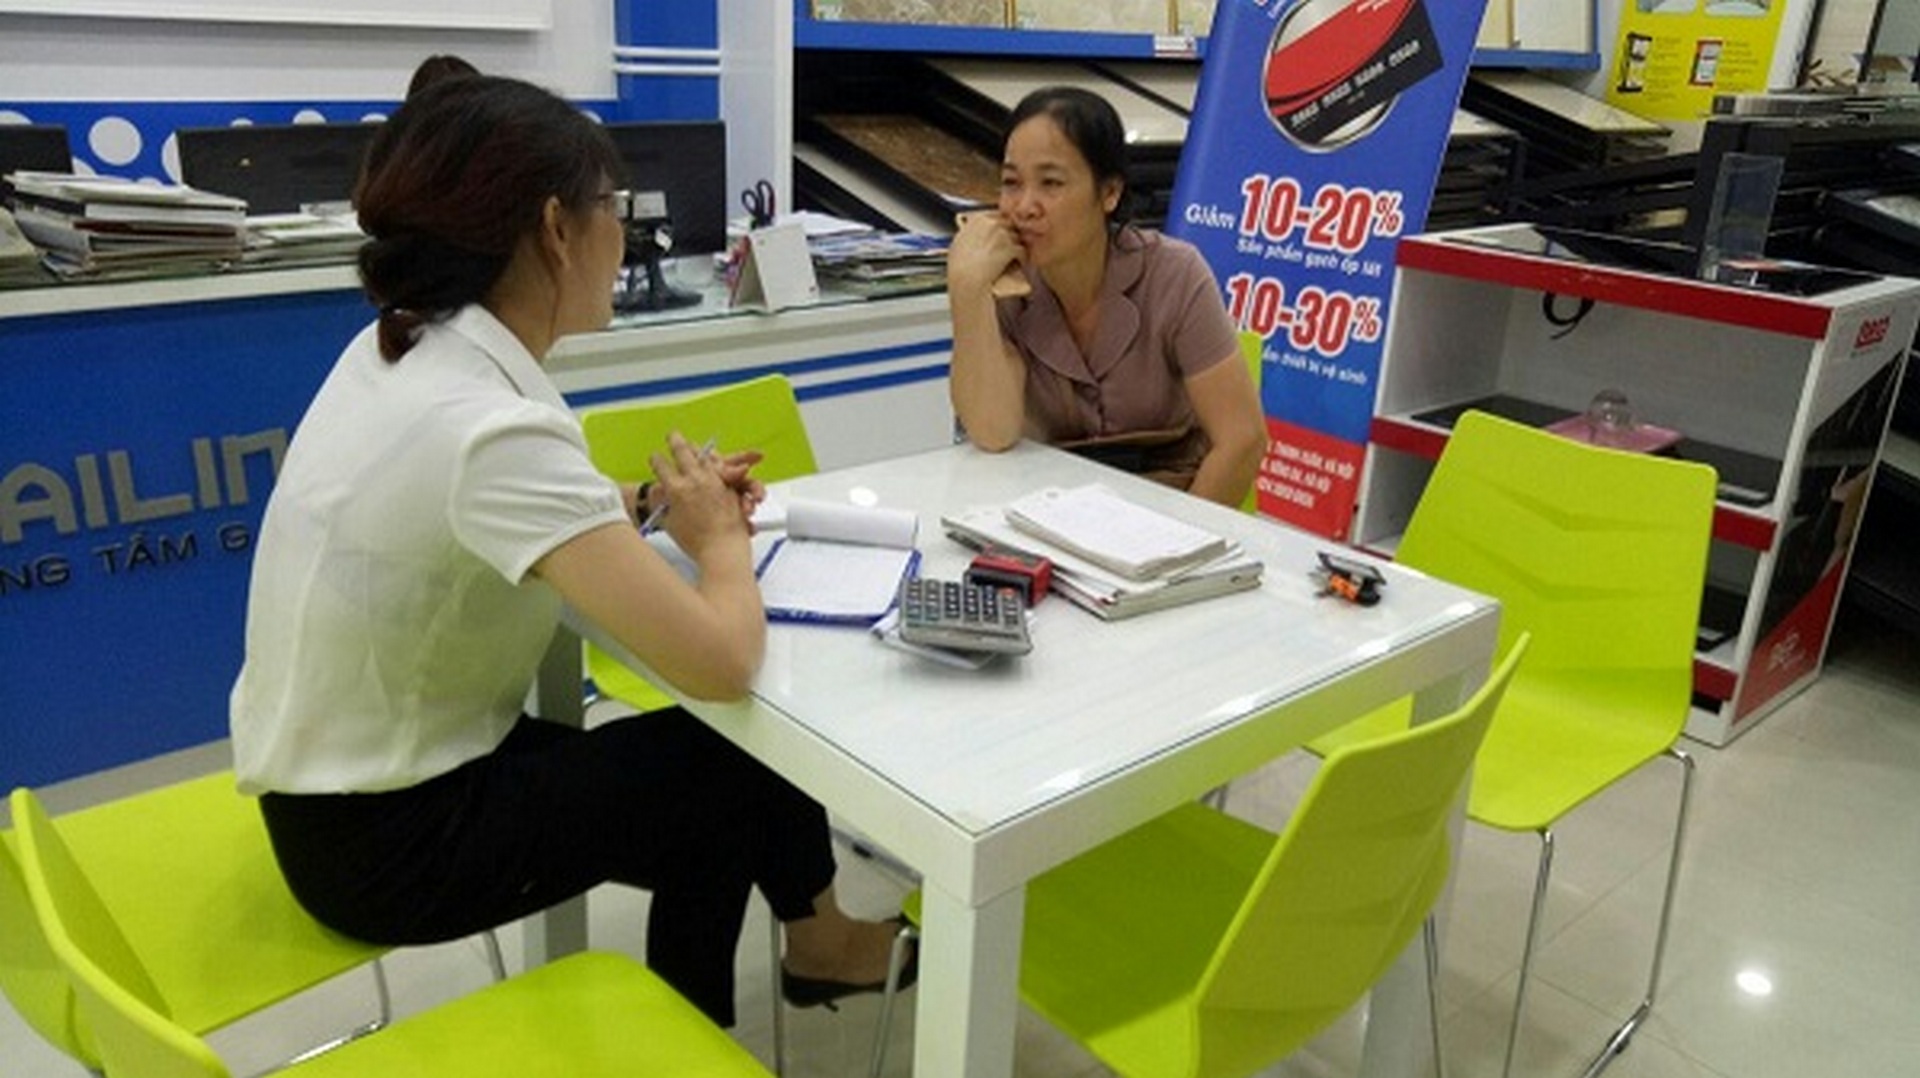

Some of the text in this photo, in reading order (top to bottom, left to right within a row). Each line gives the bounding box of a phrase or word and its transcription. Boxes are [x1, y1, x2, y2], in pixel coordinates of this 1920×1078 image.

[1184, 172, 1406, 255] Giảm 10-20%
[1227, 271, 1383, 358] 10-30%
[92, 527, 200, 575] TÂM
